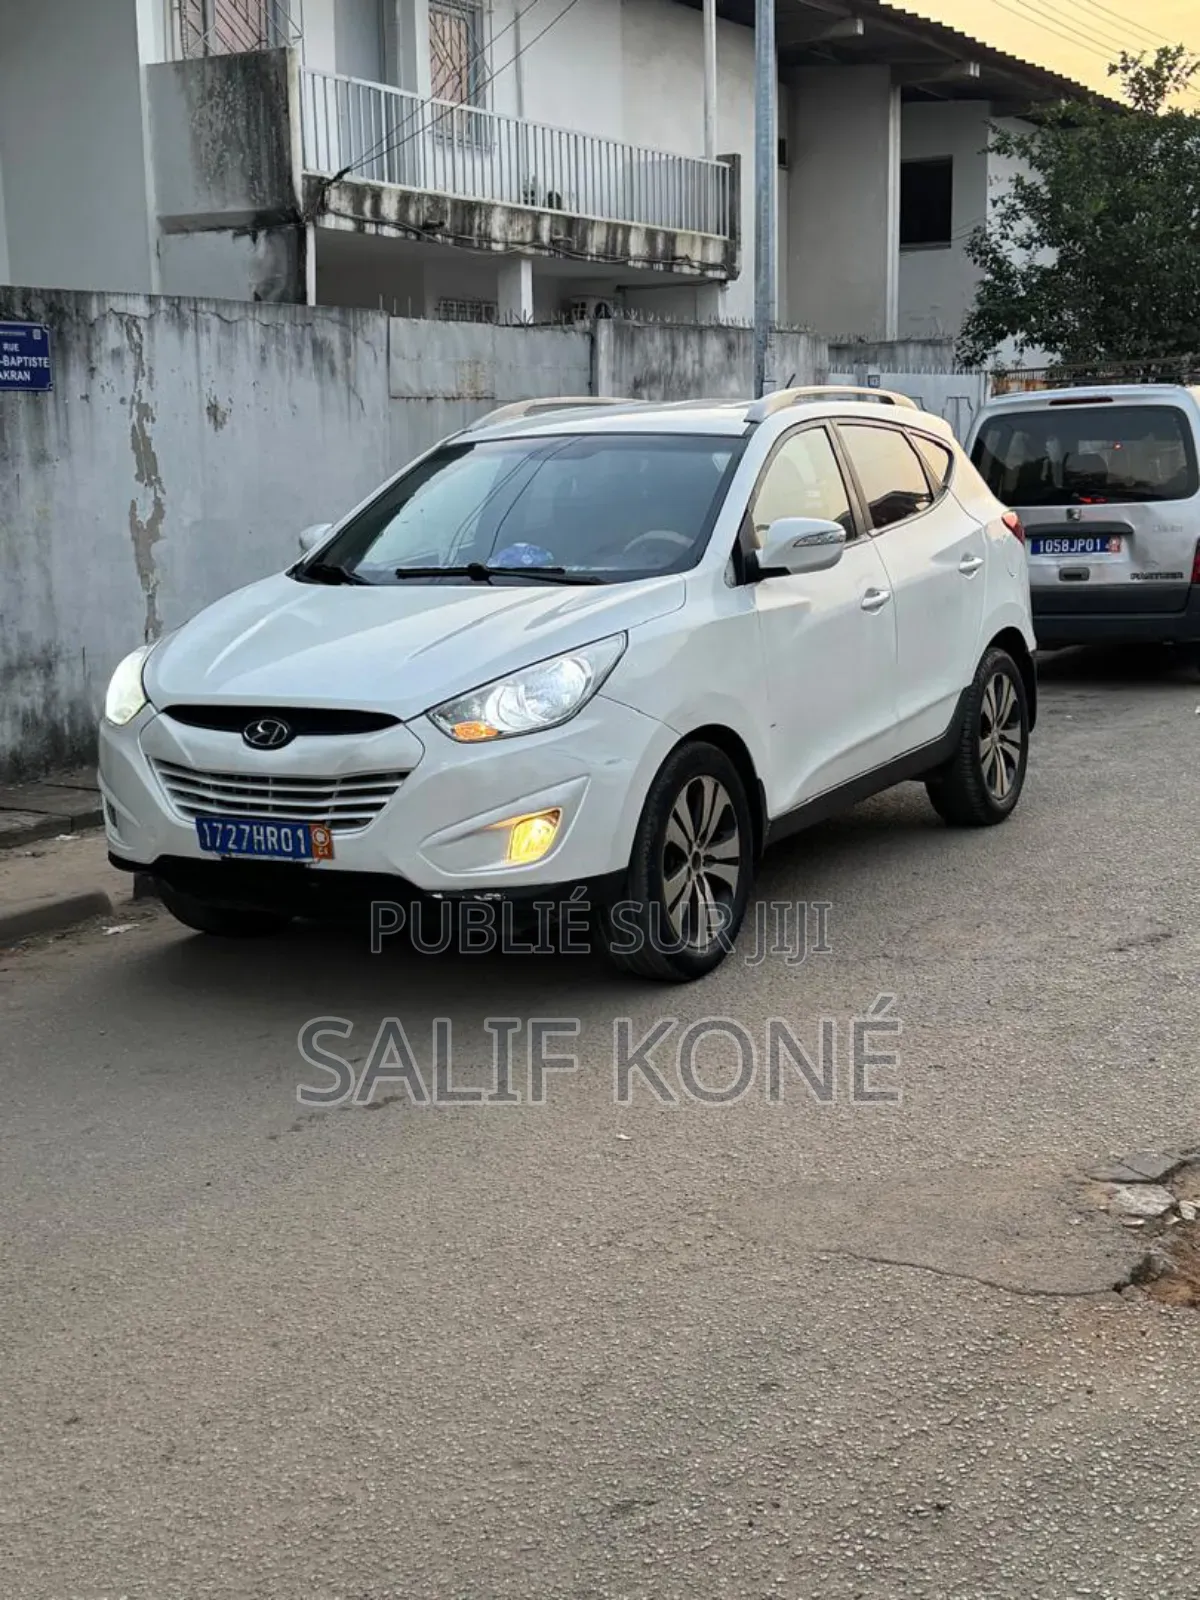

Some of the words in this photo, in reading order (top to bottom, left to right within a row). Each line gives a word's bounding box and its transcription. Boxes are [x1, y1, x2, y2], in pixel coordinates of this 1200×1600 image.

[2, 343, 20, 352] RUE
[1038, 538, 1100, 552] 1058JP01
[202, 822, 306, 855] 1727HR01
